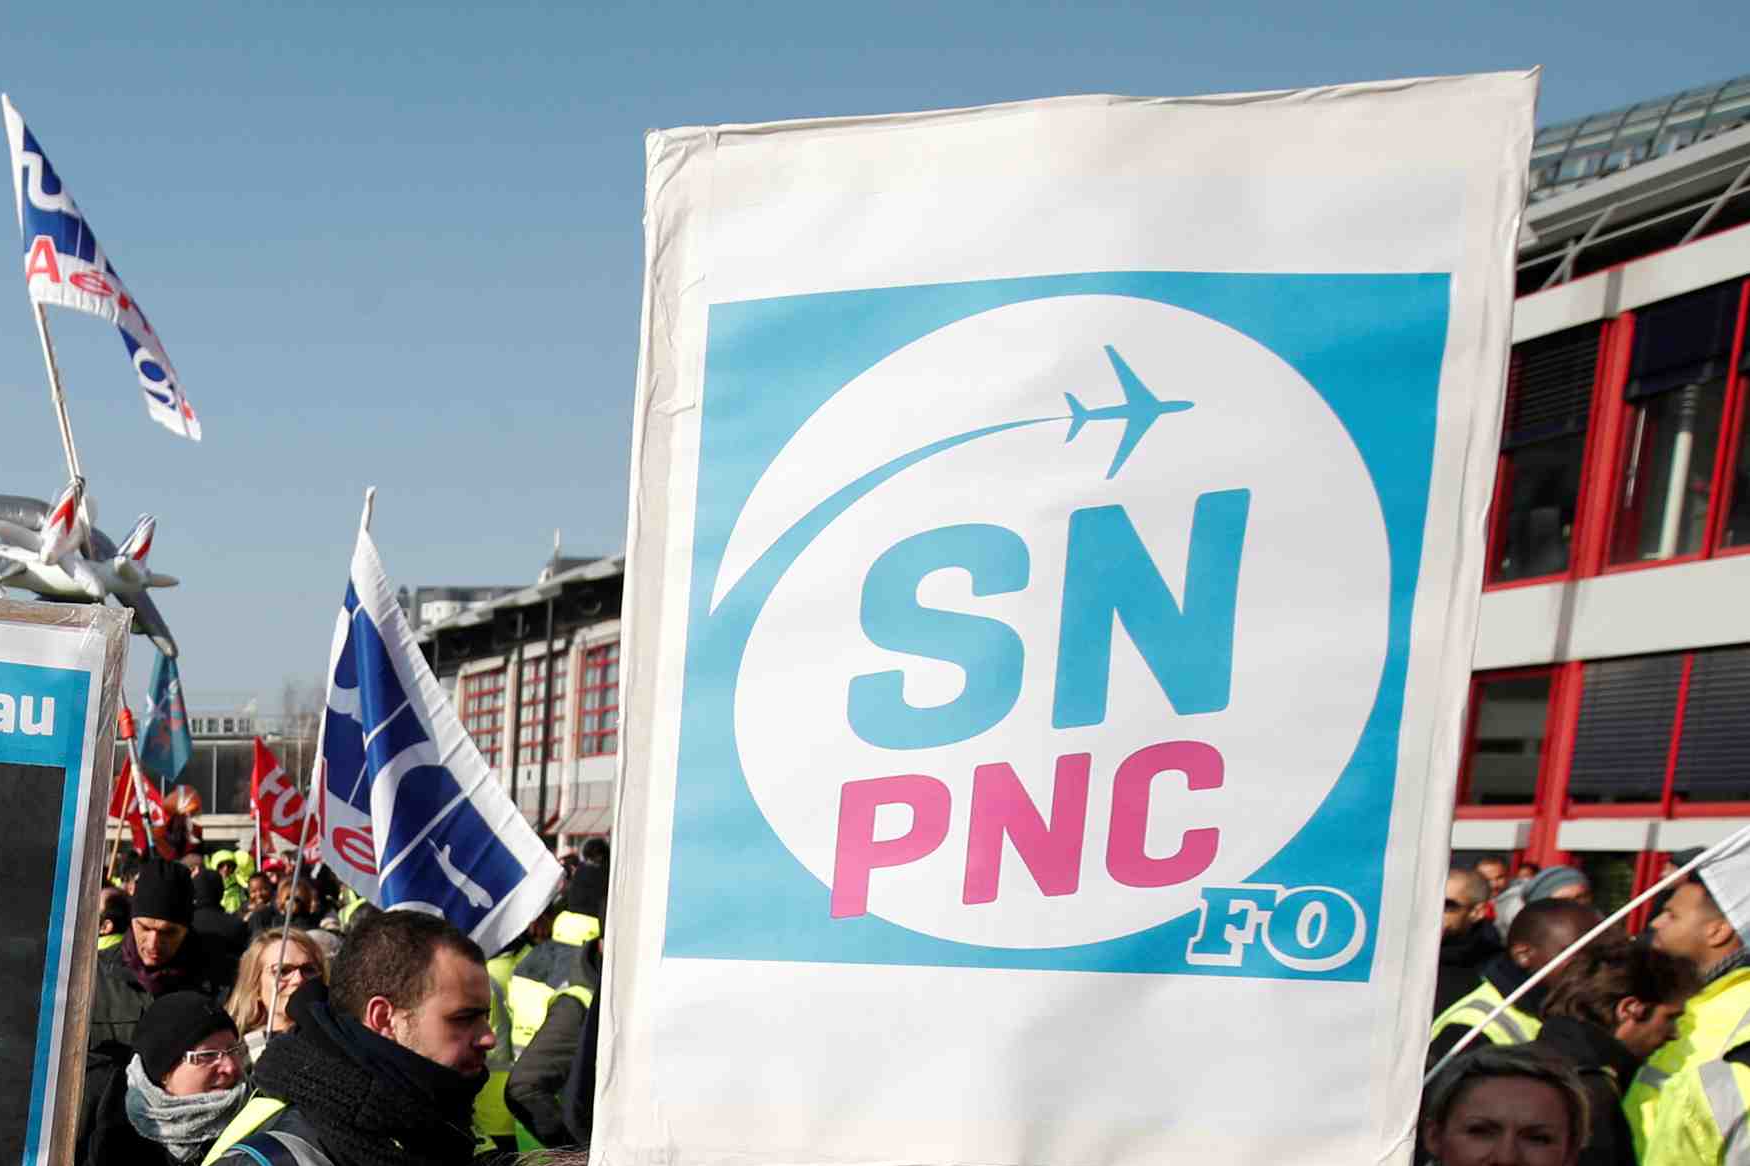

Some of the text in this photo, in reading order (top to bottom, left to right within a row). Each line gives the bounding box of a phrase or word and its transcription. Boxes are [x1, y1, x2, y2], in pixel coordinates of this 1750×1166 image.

[847, 487, 1251, 750] SN
[830, 740, 1225, 919] PNC
[1186, 885, 1367, 971] FO
